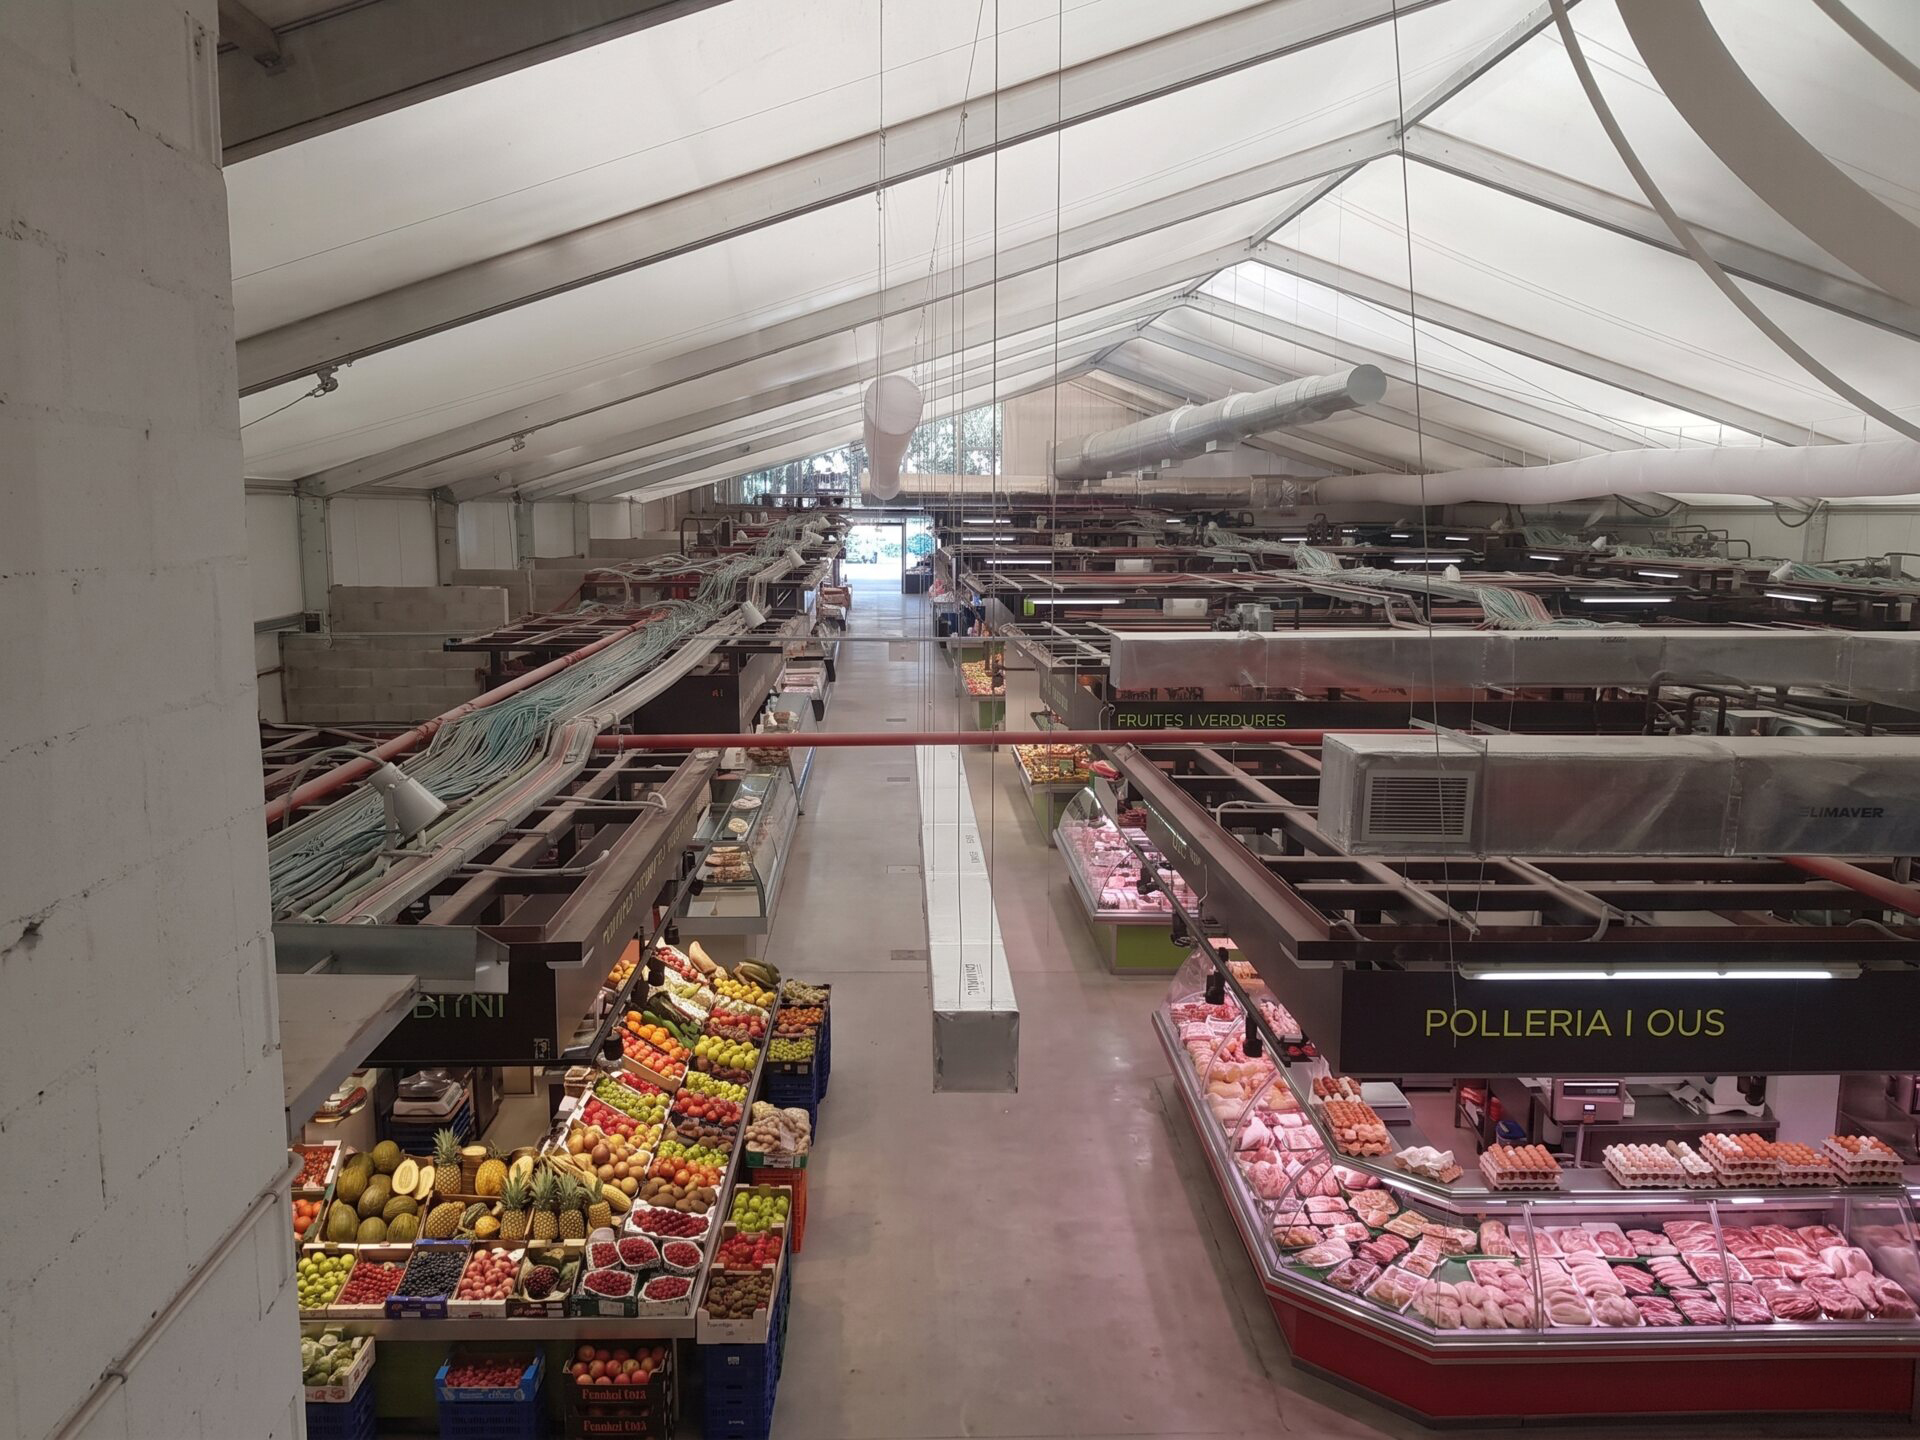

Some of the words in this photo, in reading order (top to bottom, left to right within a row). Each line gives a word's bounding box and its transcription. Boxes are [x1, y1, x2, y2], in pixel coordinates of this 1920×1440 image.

[1117, 713, 1184, 727] FRUITES
[1189, 713, 1193, 727] I
[1197, 713, 1287, 727] VERDURES
[1425, 1008, 1612, 1037] POLLERIA
[1625, 1009, 1632, 1037] I
[1646, 1008, 1725, 1037] OUS
